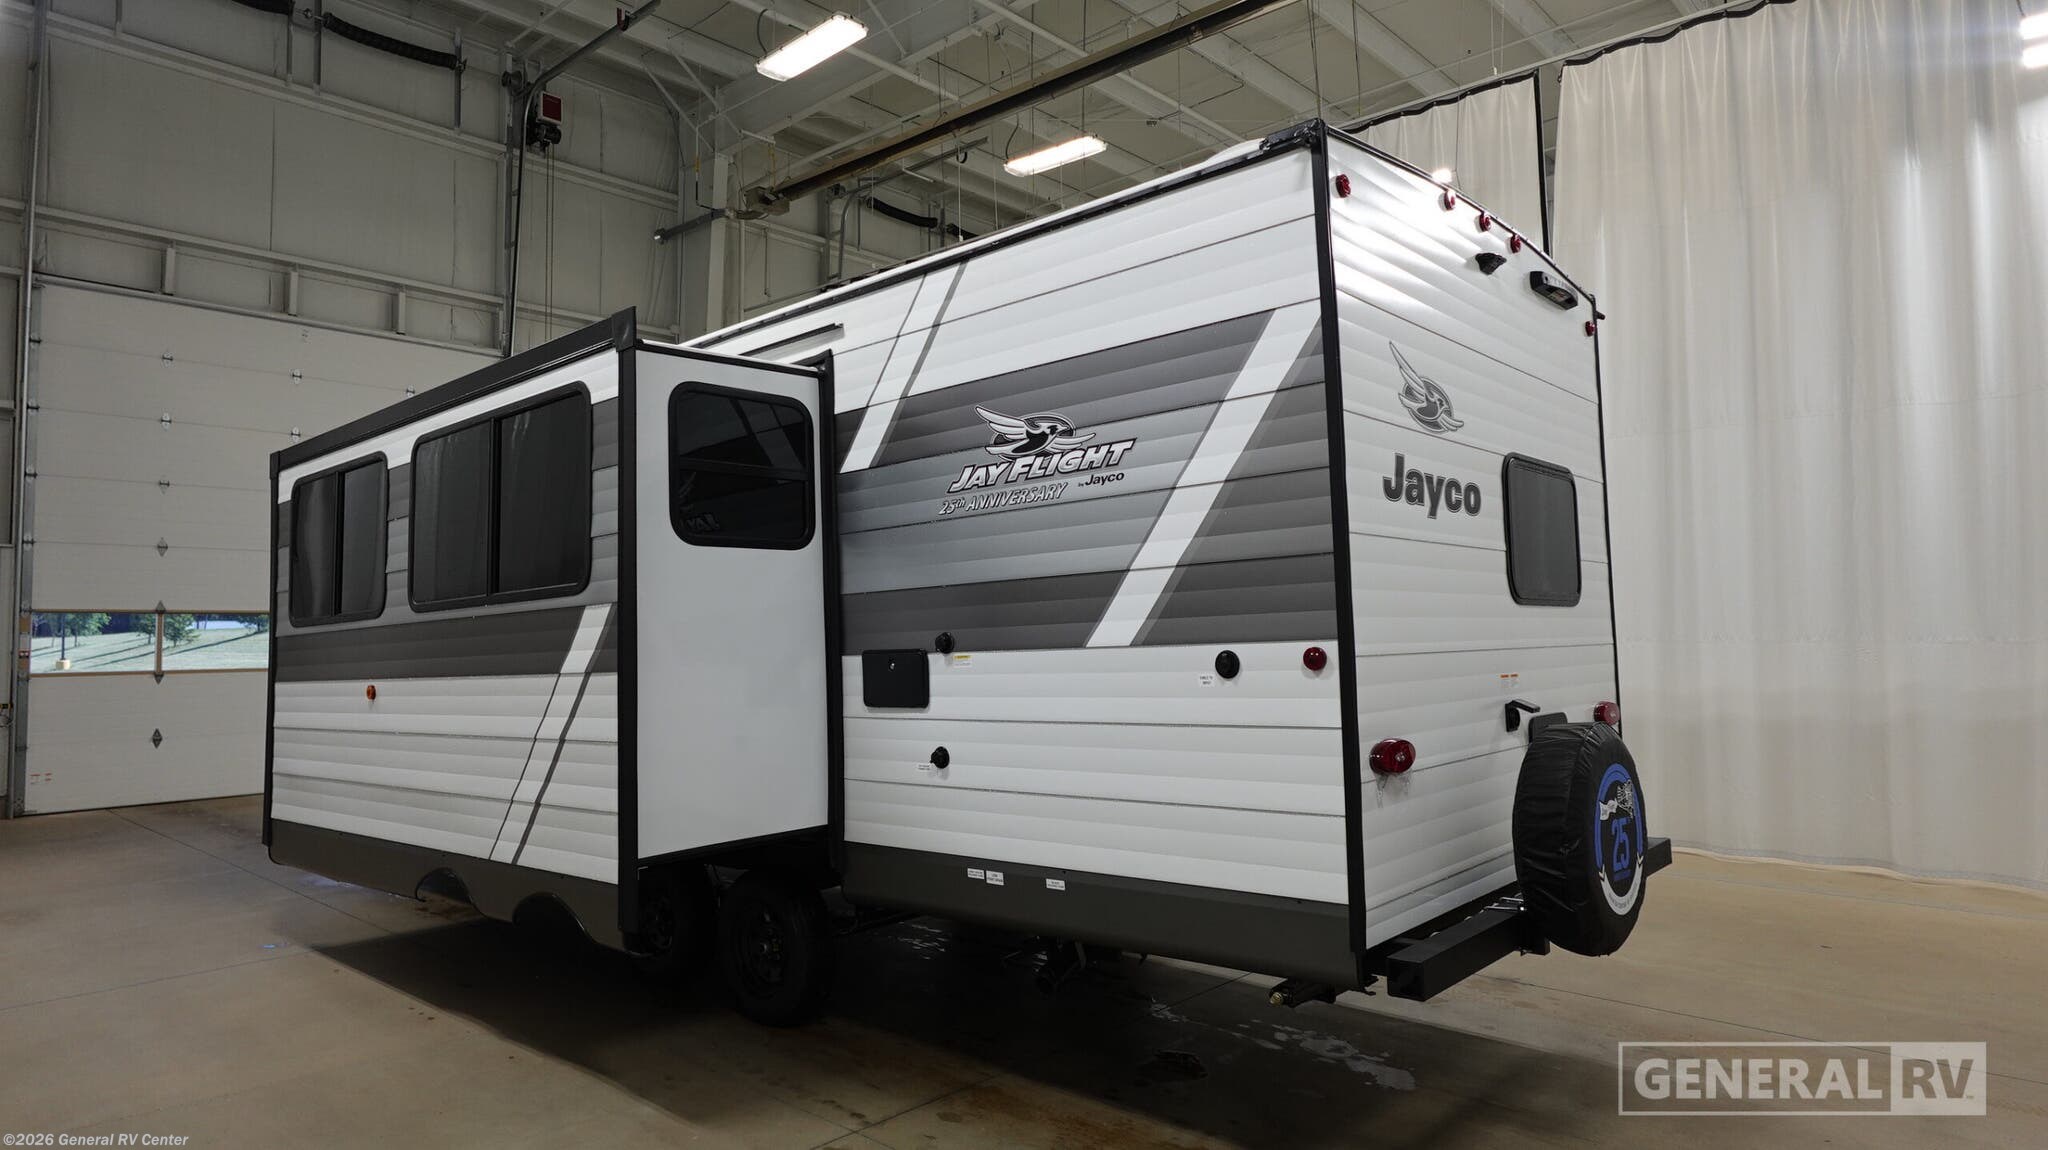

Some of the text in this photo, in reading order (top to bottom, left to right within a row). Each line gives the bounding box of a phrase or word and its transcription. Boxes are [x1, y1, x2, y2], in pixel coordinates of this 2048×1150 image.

[947, 437, 1138, 494] JAY FLIGHT
[1085, 472, 1125, 486] Jayco
[1382, 452, 1481, 519] Jayco
[938, 481, 1069, 516] 25th ANNIVERSARY
[1611, 817, 1630, 872] 25
